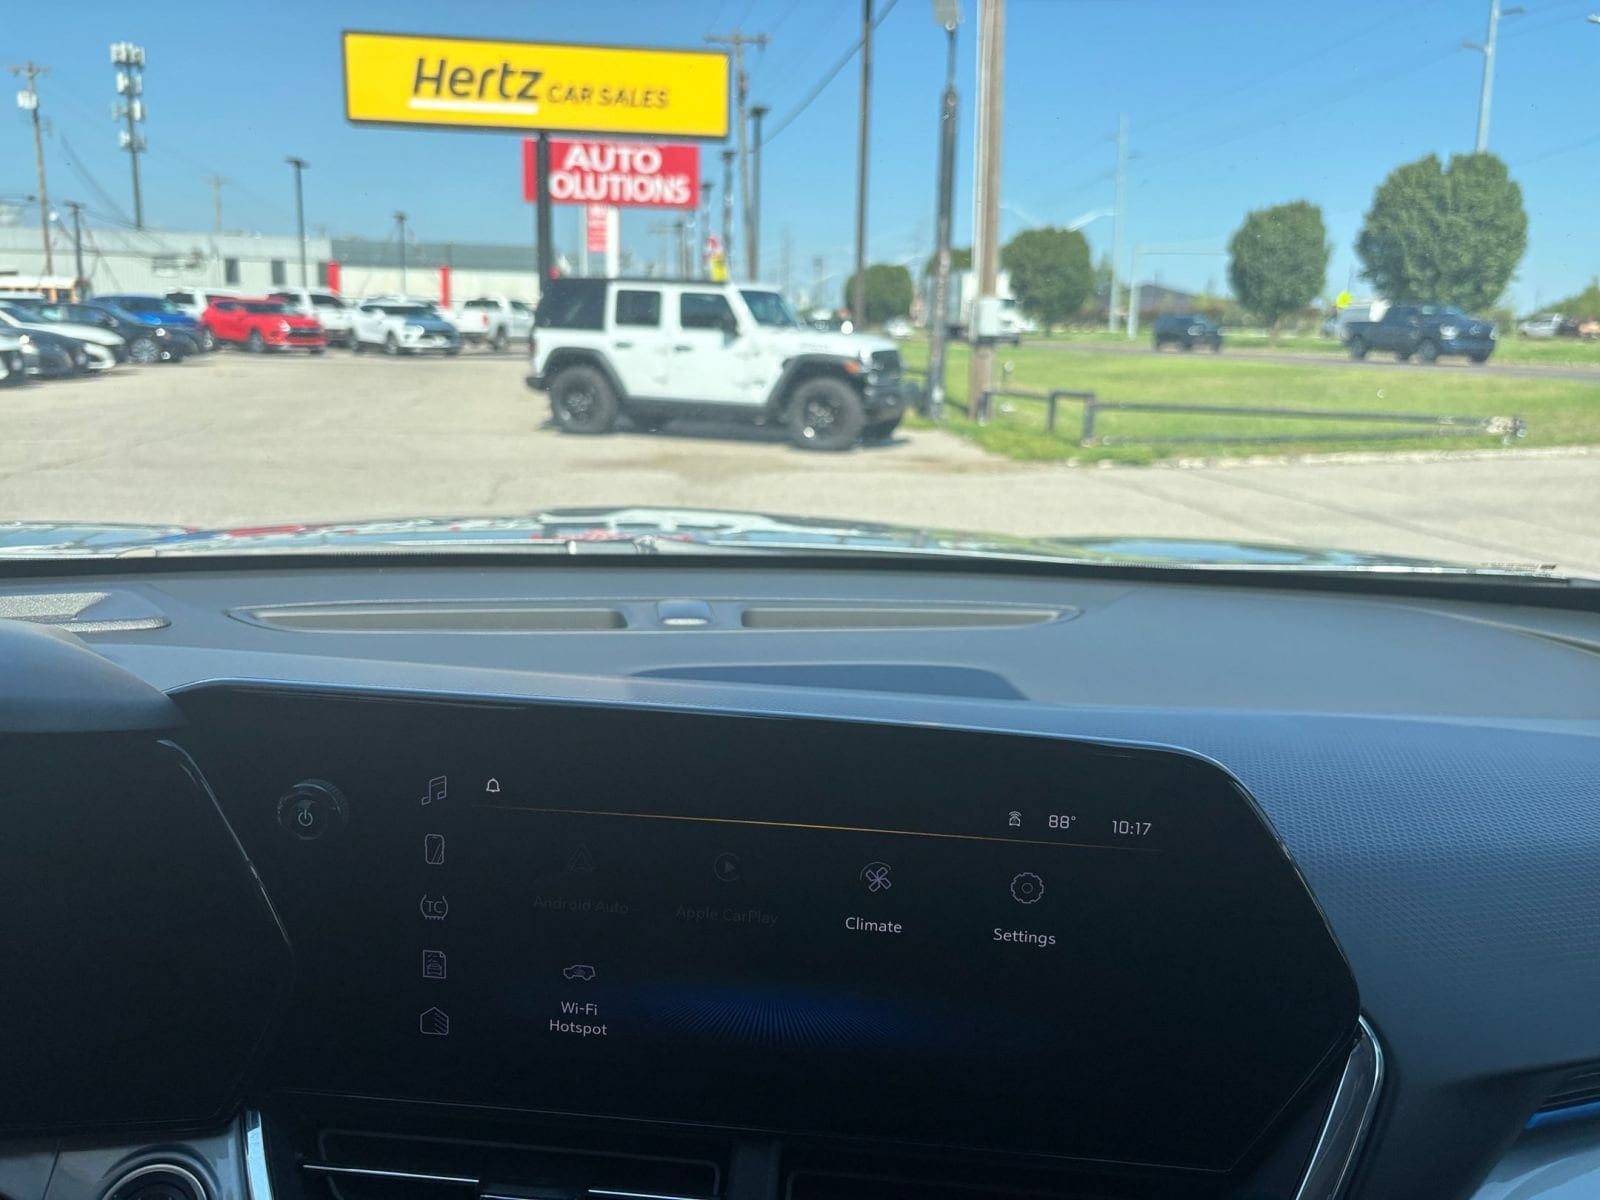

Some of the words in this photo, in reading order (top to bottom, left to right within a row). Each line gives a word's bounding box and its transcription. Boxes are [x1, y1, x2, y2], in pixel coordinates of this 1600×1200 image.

[412, 56, 544, 100] Hertz
[548, 84, 593, 104] CAR
[596, 86, 670, 110] SALES
[561, 142, 663, 176] AUTO
[548, 169, 692, 205] OLUTIONS
[1111, 820, 1153, 837] 10:17
[532, 895, 592, 913] Android
[595, 899, 630, 915] Auto
[675, 904, 719, 921] Apple
[722, 907, 779, 928] CarPlay
[844, 916, 903, 934] Climate
[992, 927, 1057, 948] Settings
[560, 1000, 599, 1017] Wi-Fi
[549, 1018, 608, 1037] Hotspot
